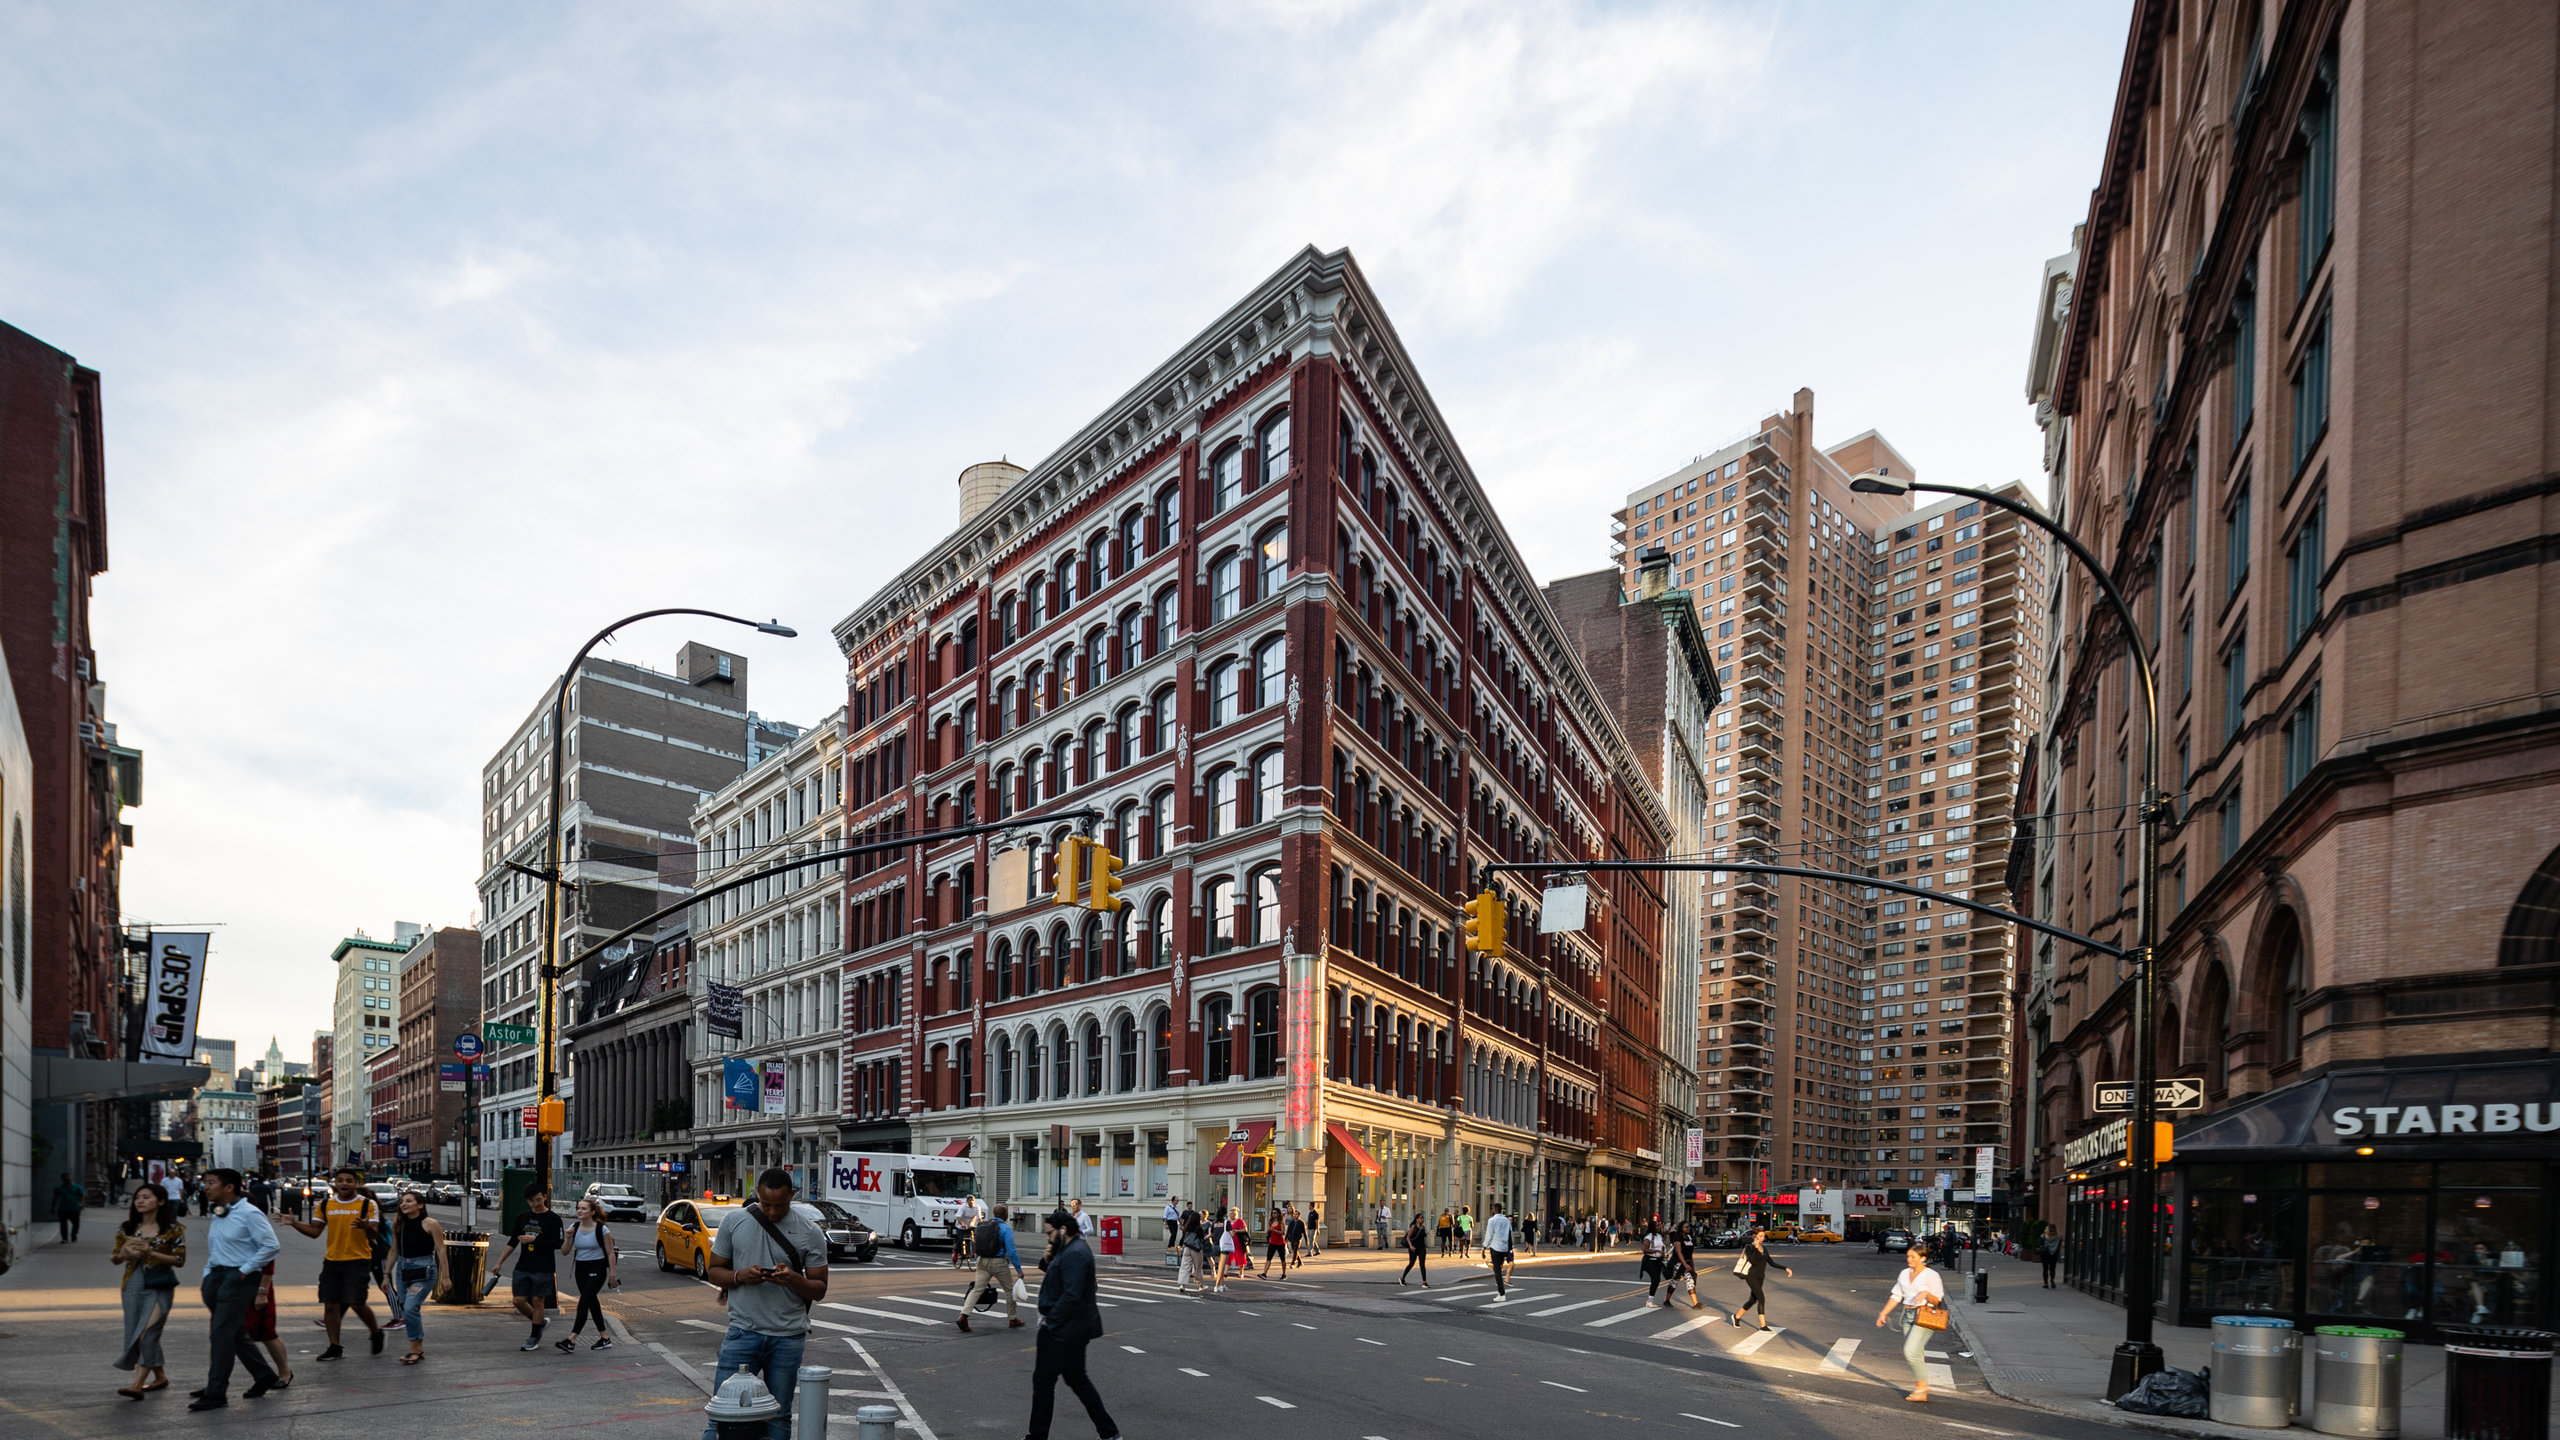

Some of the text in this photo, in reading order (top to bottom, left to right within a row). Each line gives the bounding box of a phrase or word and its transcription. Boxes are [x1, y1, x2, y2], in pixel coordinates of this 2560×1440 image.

[489, 1025, 533, 1040] Astor Pl
[765, 1072, 784, 1089] 25
[766, 1088, 784, 1097] YEARS
[2064, 1117, 2127, 1169] STARBUCKS COFFEE
[832, 1157, 882, 1192] FedEx
[1809, 1197, 1824, 1209] elf
